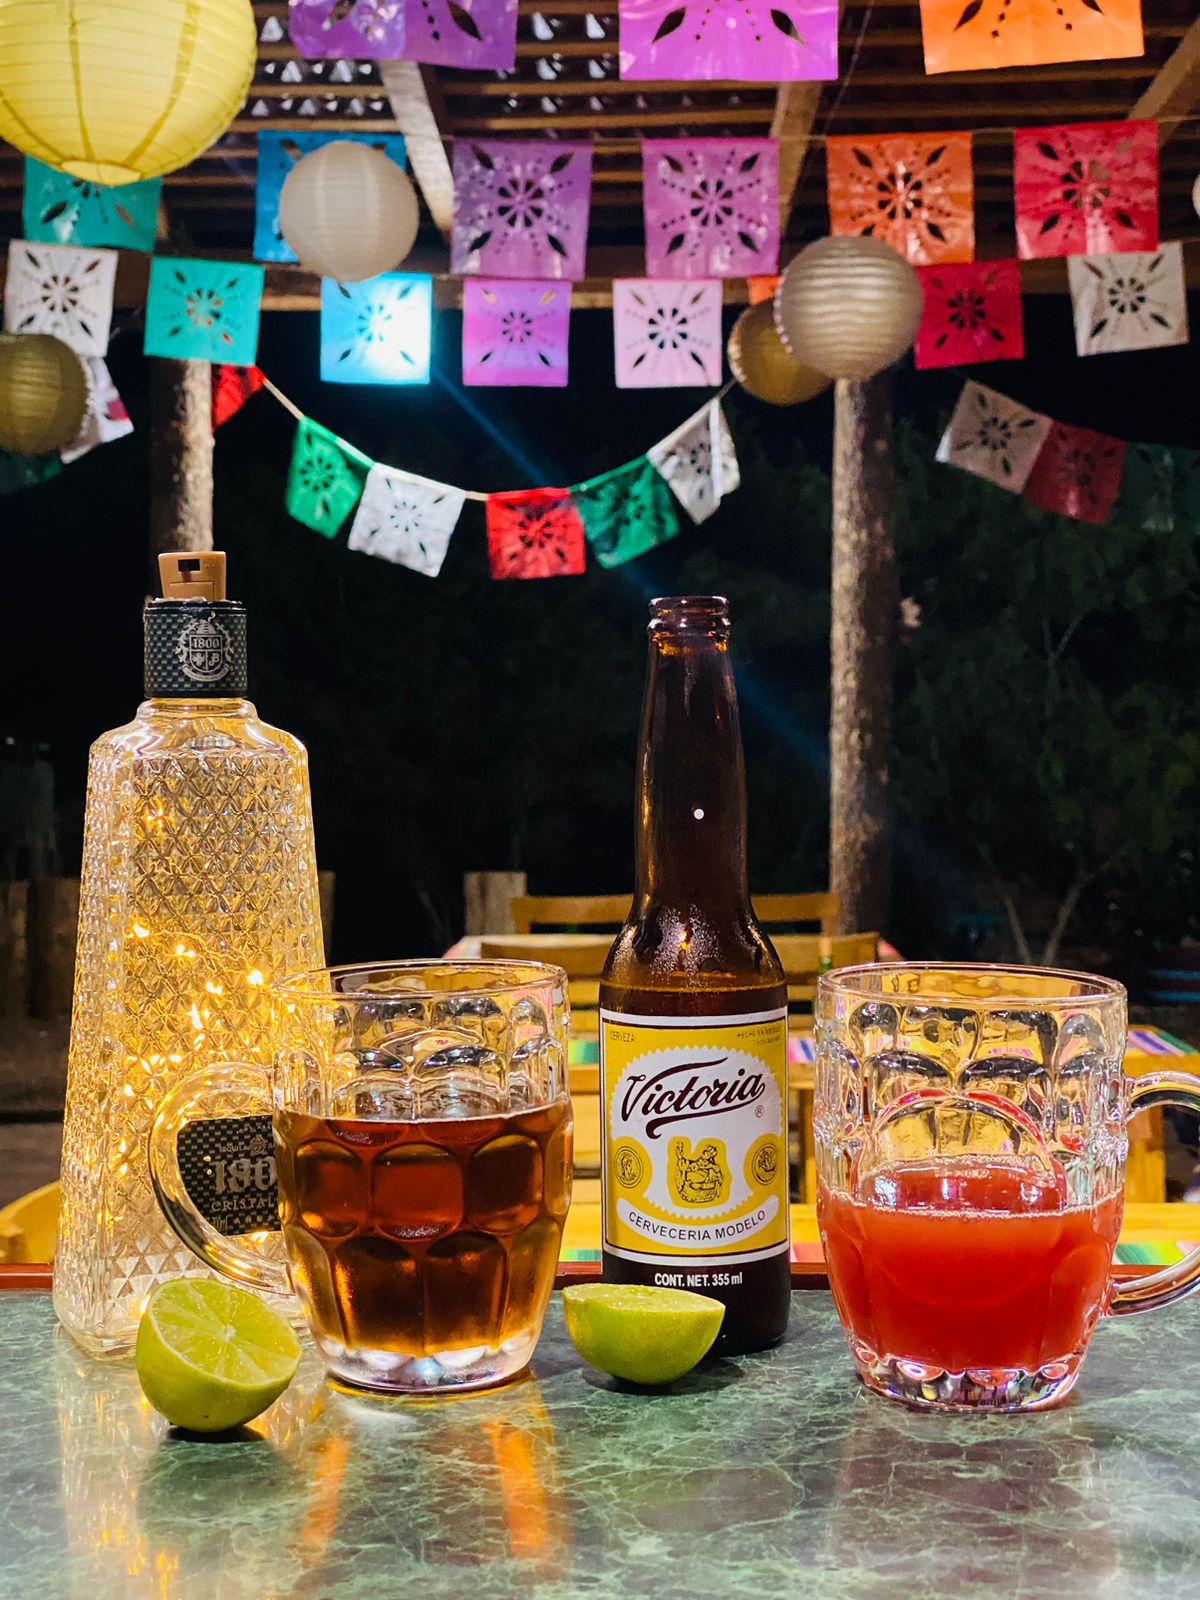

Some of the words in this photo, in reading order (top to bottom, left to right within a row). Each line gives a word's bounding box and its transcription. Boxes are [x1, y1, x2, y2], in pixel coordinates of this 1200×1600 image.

[192, 638, 219, 649] 1800
[621, 1057, 766, 1139] Victoria
[210, 1156, 277, 1194] 180
[628, 1211, 711, 1241] CERVECERIA
[715, 1209, 766, 1239] MODELO
[654, 1272, 685, 1287] CONT.
[686, 1274, 710, 1287] NET.
[712, 1273, 730, 1286] 355
[731, 1272, 743, 1285] ml
